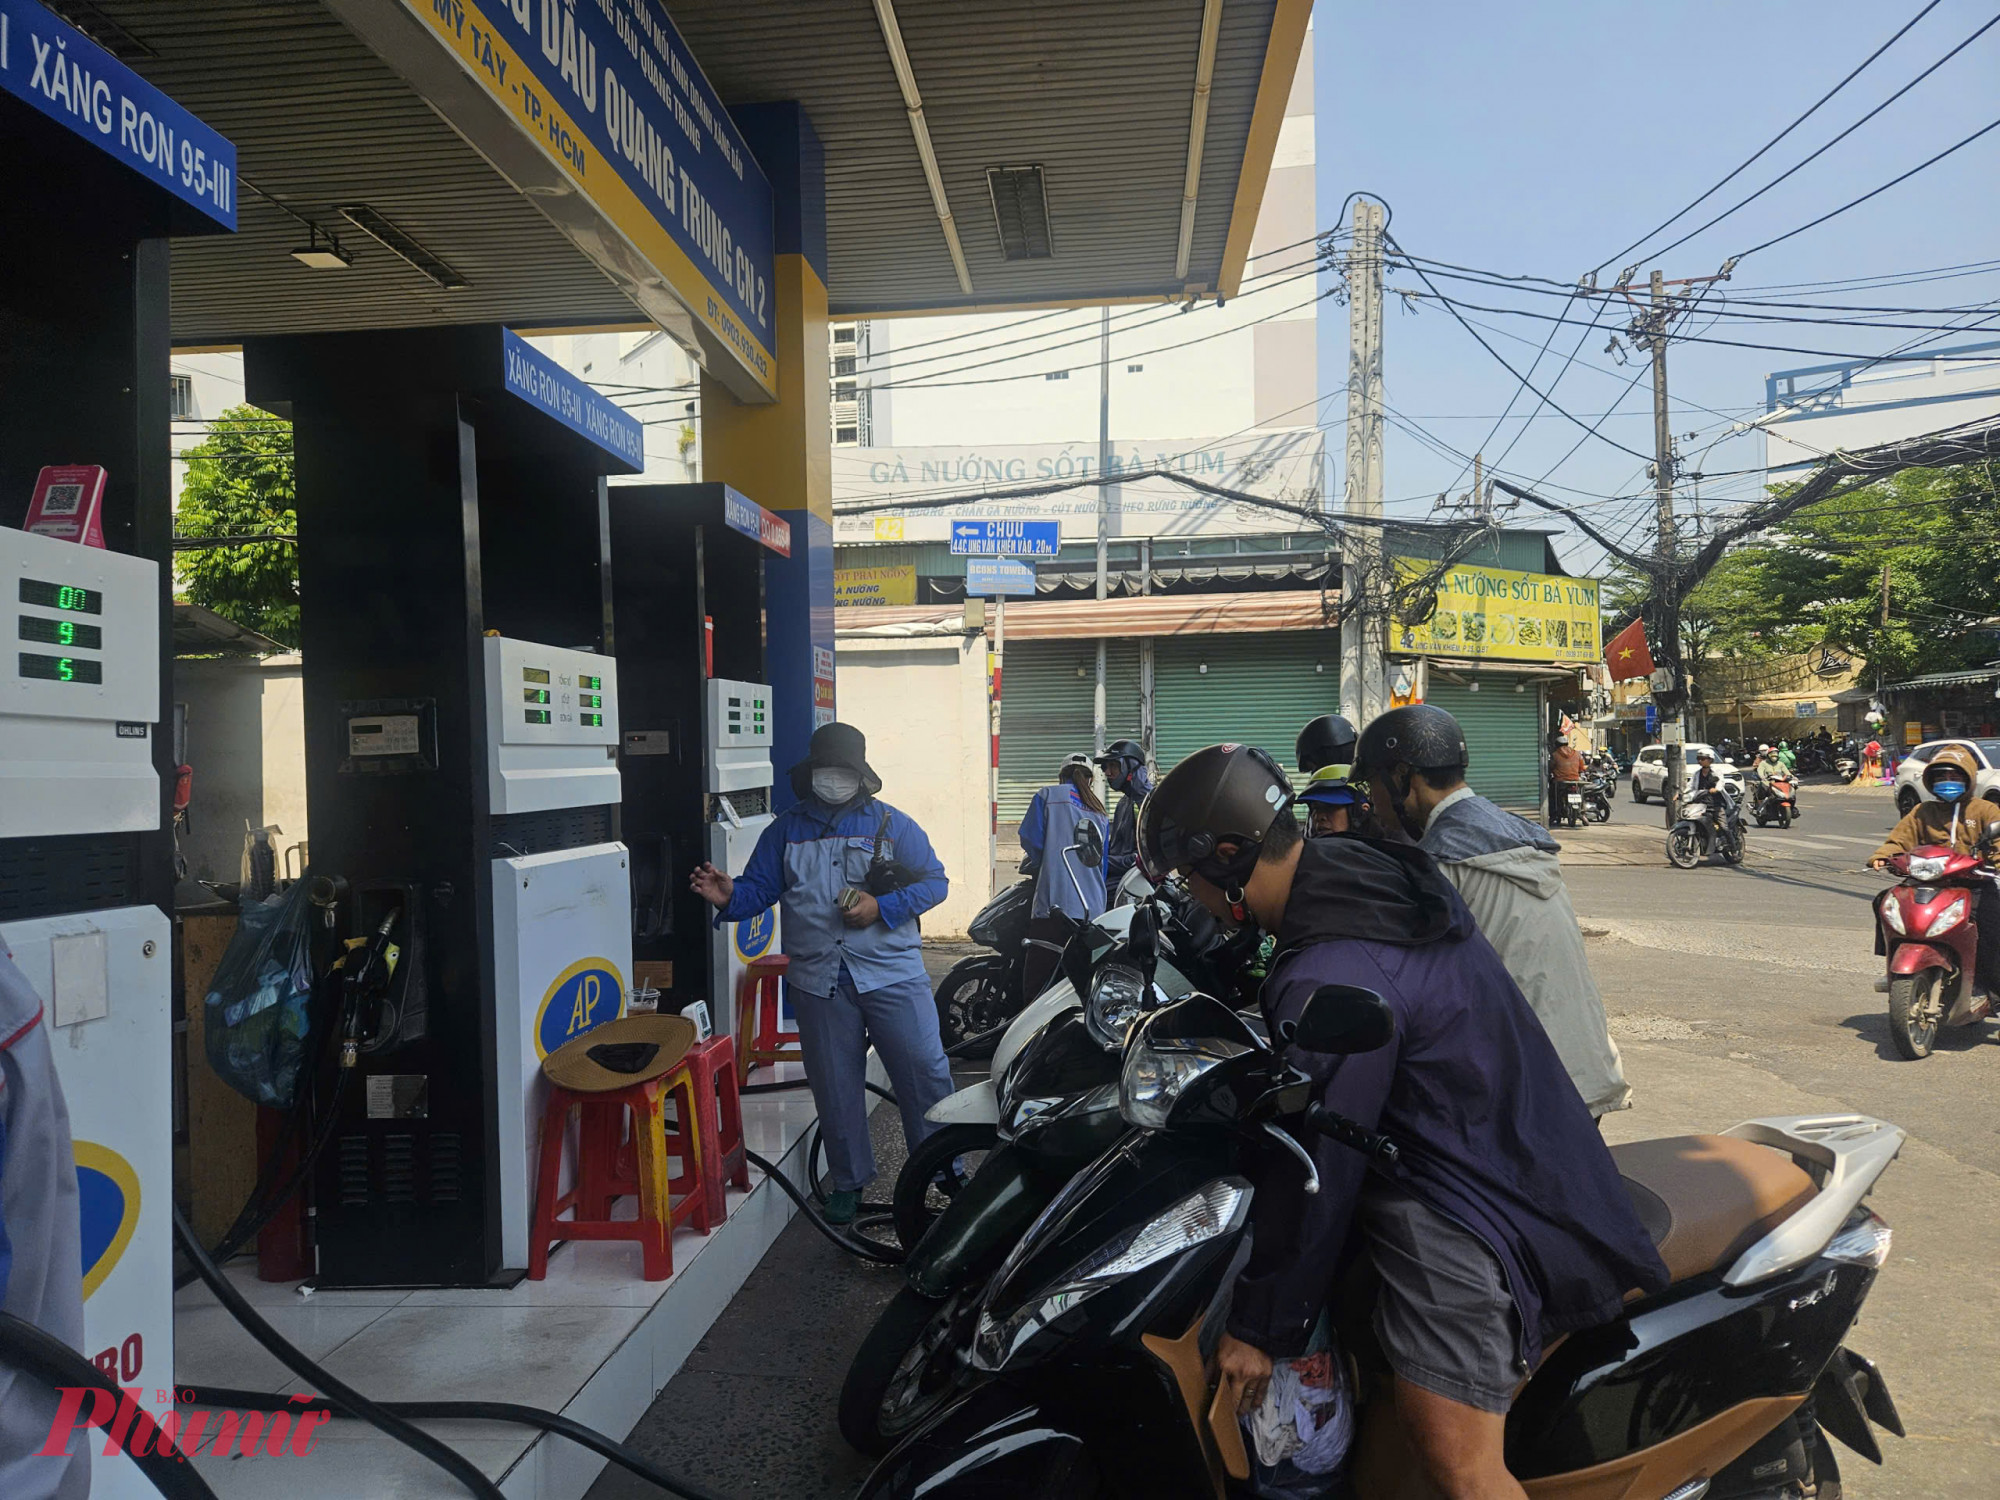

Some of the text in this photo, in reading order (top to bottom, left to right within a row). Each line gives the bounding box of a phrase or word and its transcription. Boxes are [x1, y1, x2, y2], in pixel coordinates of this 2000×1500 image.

[471, 23, 507, 87] TÂY
[522, 82, 543, 131] TP.
[549, 112, 585, 177] HCM
[640, 45, 672, 111] QUANG
[673, 95, 700, 154] TRUNG
[670, 49, 689, 97] KINH
[690, 80, 713, 135] DOANH
[30, 33, 112, 134] XĂNG
[121, 96, 174, 176] RON
[181, 139, 230, 213] 95-III
[604, 67, 676, 216] QUANG
[680, 166, 732, 288] TRUNG
[736, 245, 756, 315] CN
[757, 275, 766, 328] 2
[707, 296, 721, 326] ĐT:
[508, 348, 537, 397] XĂNG
[539, 370, 560, 411] RON
[561, 388, 582, 425] 95-III
[586, 399, 609, 441] XĂNG
[610, 417, 626, 452] RON
[870, 454, 909, 484] GÀ
[920, 453, 1026, 483] NƯỚNG
[1036, 445, 1095, 482] SỐT
[1156, 451, 1225, 476] YUM
[761, 518, 771, 541] DO
[877, 519, 902, 538] 42
[953, 539, 967, 553] 44C
[968, 540, 981, 553] UNG
[999, 565, 1026, 575] TOWER
[846, 584, 880, 595] NƯỚNG
[852, 596, 886, 607] NƯỚNG
[1454, 572, 1508, 598] NƯỚNG
[1511, 574, 1540, 601] SỐT
[1544, 580, 1562, 604] BÀ
[1565, 586, 1595, 607] YUM
[59, 621, 74, 645] 9
[59, 657, 73, 681] 5
[566, 974, 601, 1035] AP
